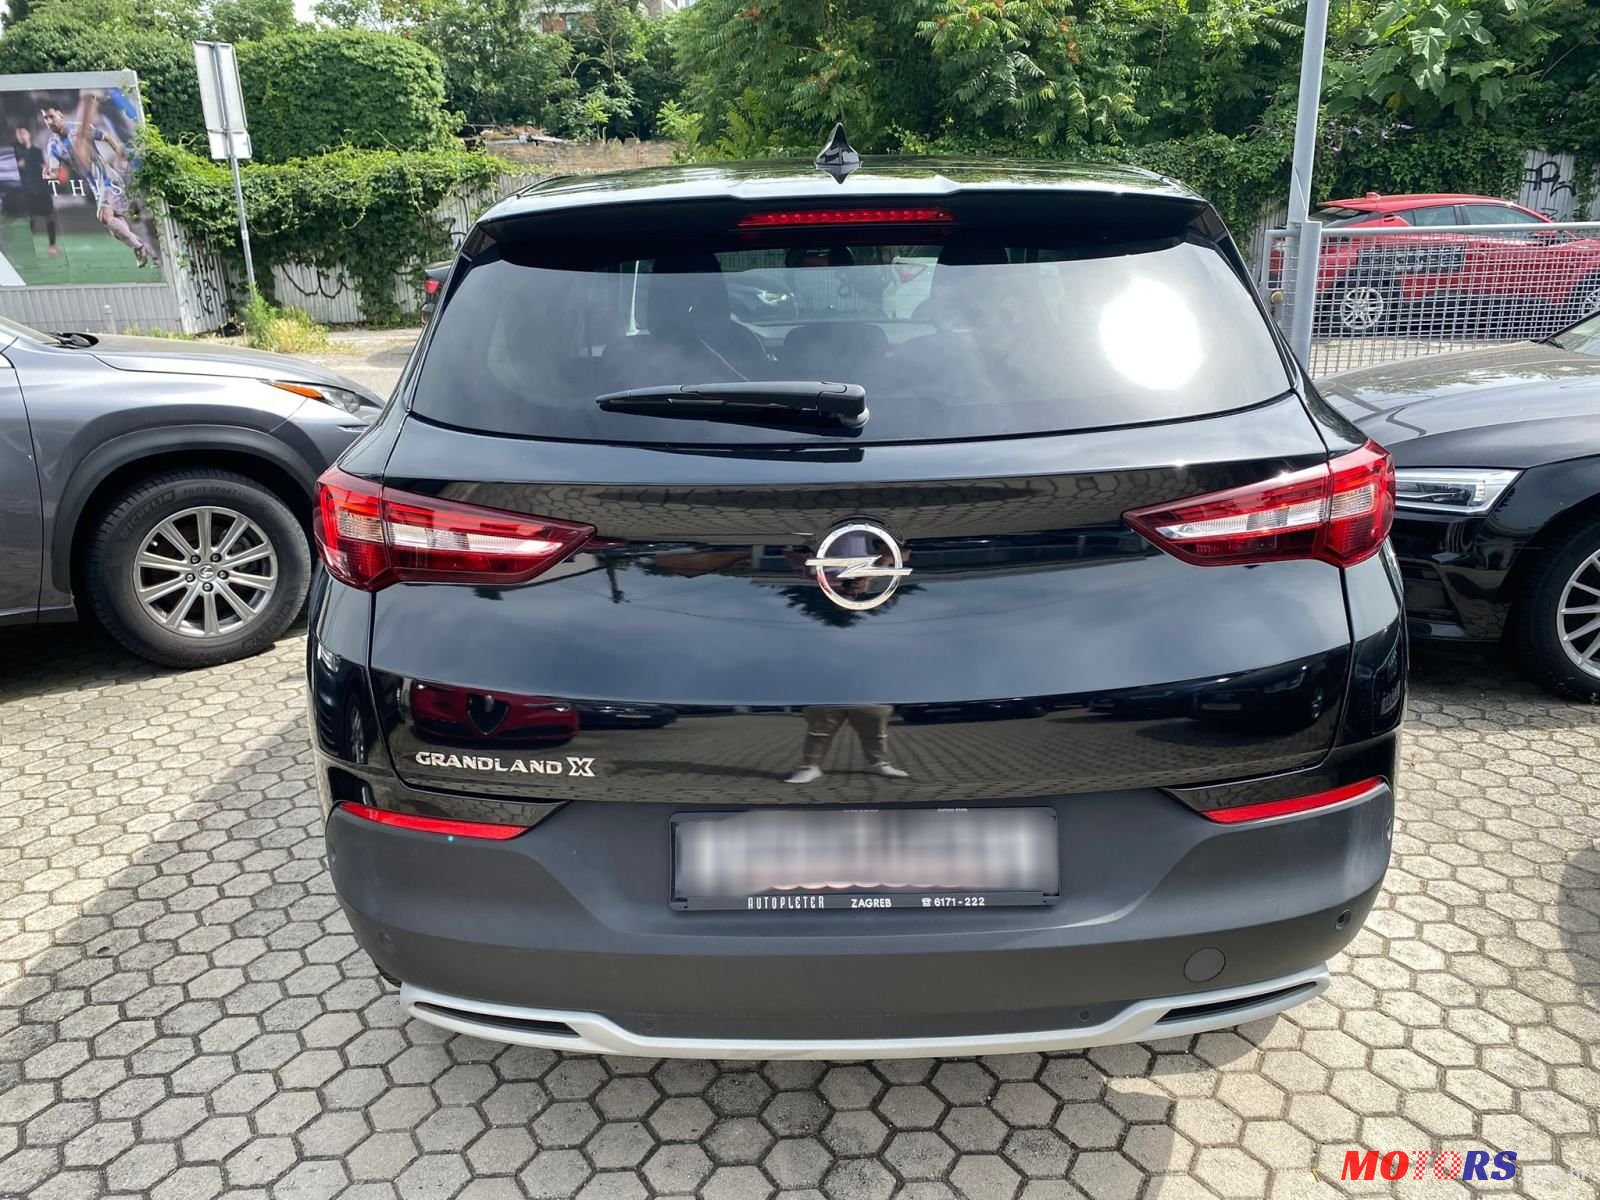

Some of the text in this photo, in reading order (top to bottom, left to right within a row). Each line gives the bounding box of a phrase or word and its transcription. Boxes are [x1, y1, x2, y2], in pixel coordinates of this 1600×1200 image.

[48, 180, 121, 197] THIS
[415, 752, 596, 777] GRANDLAND X
[747, 895, 825, 909] AUTOPLETER
[851, 898, 892, 908] ZAGREB
